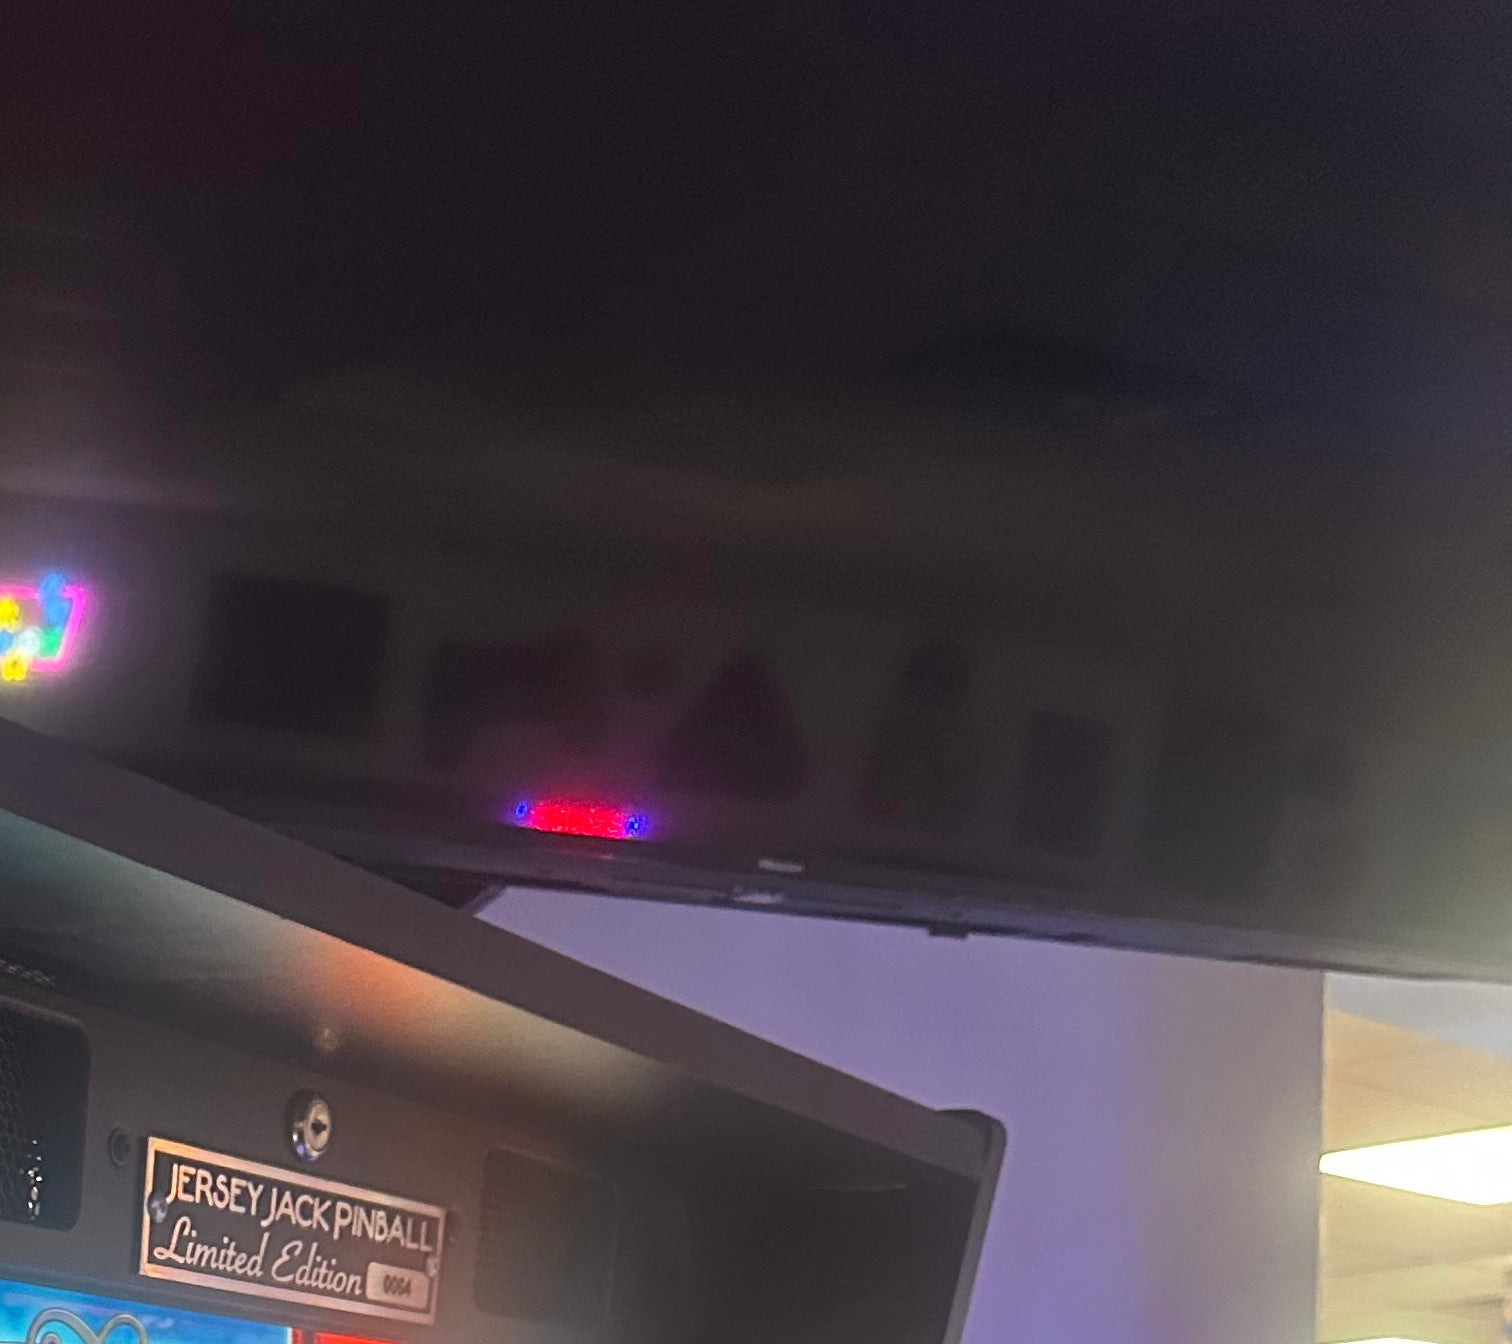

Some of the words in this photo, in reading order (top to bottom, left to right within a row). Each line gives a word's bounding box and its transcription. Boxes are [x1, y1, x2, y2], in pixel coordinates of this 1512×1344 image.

[166, 1162, 264, 1217] JERSEY
[261, 1187, 332, 1230] JACK
[333, 1199, 434, 1252] PINBALL
[153, 1216, 270, 1278] Limited
[271, 1239, 364, 1297] Edition
